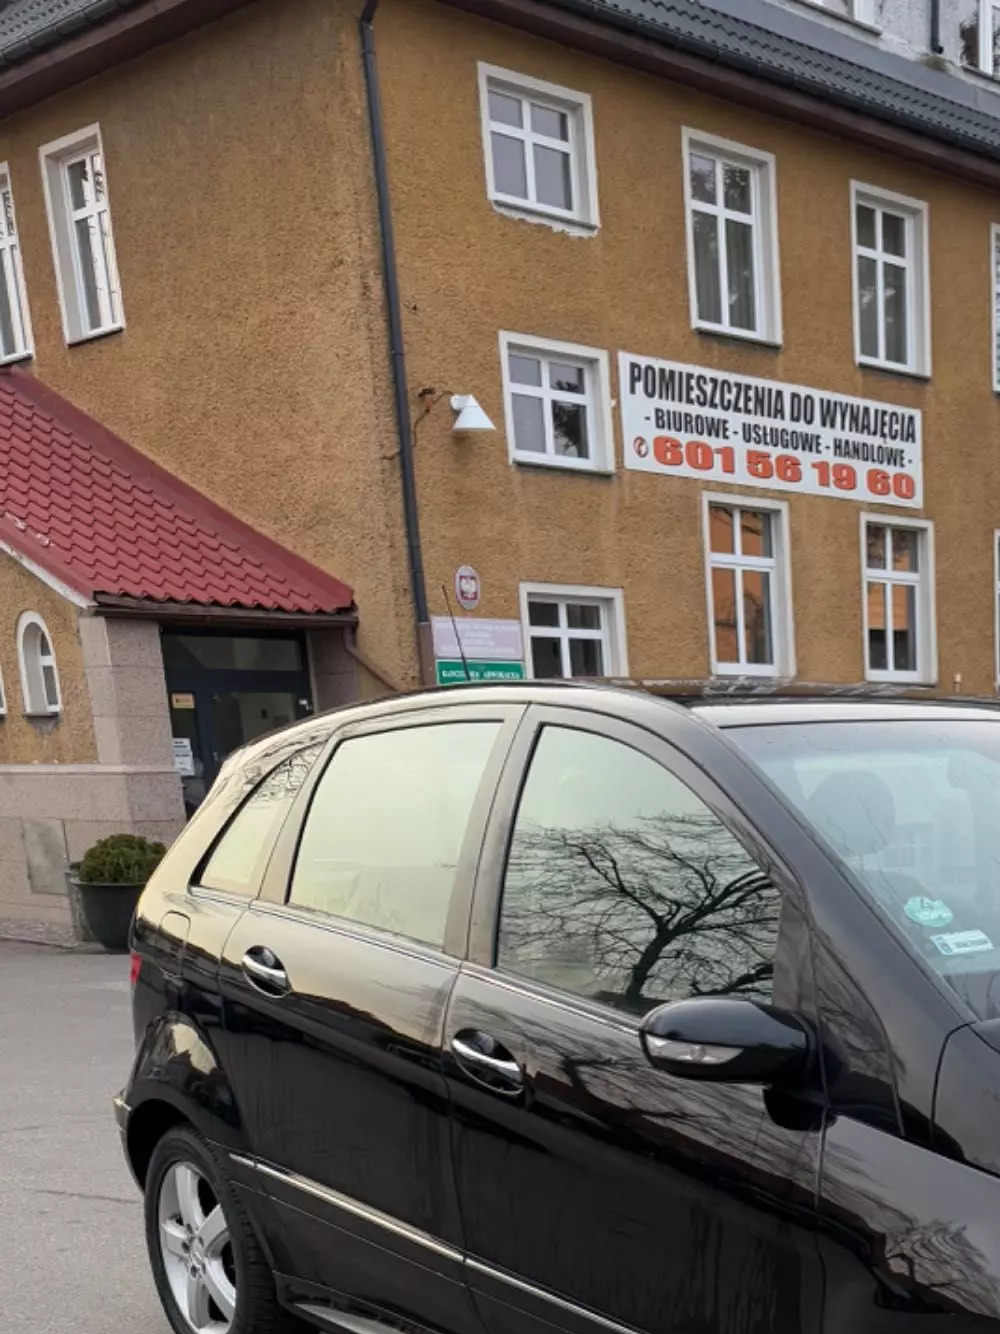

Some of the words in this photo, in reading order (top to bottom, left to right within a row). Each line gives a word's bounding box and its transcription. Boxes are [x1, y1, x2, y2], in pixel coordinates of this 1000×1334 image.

[629, 361, 785, 421] POMIESZCZENIA
[790, 392, 814, 425] DO
[820, 397, 916, 443] WYNAJĘCIA
[653, 435, 735, 475] 601
[746, 449, 802, 483] 56
[811, 461, 857, 491] 19
[866, 468, 915, 499] 60
[654, 407, 729, 440] BIUROWE
[742, 422, 822, 454] USŁUGOWE
[833, 437, 905, 468] HANDLOWE
